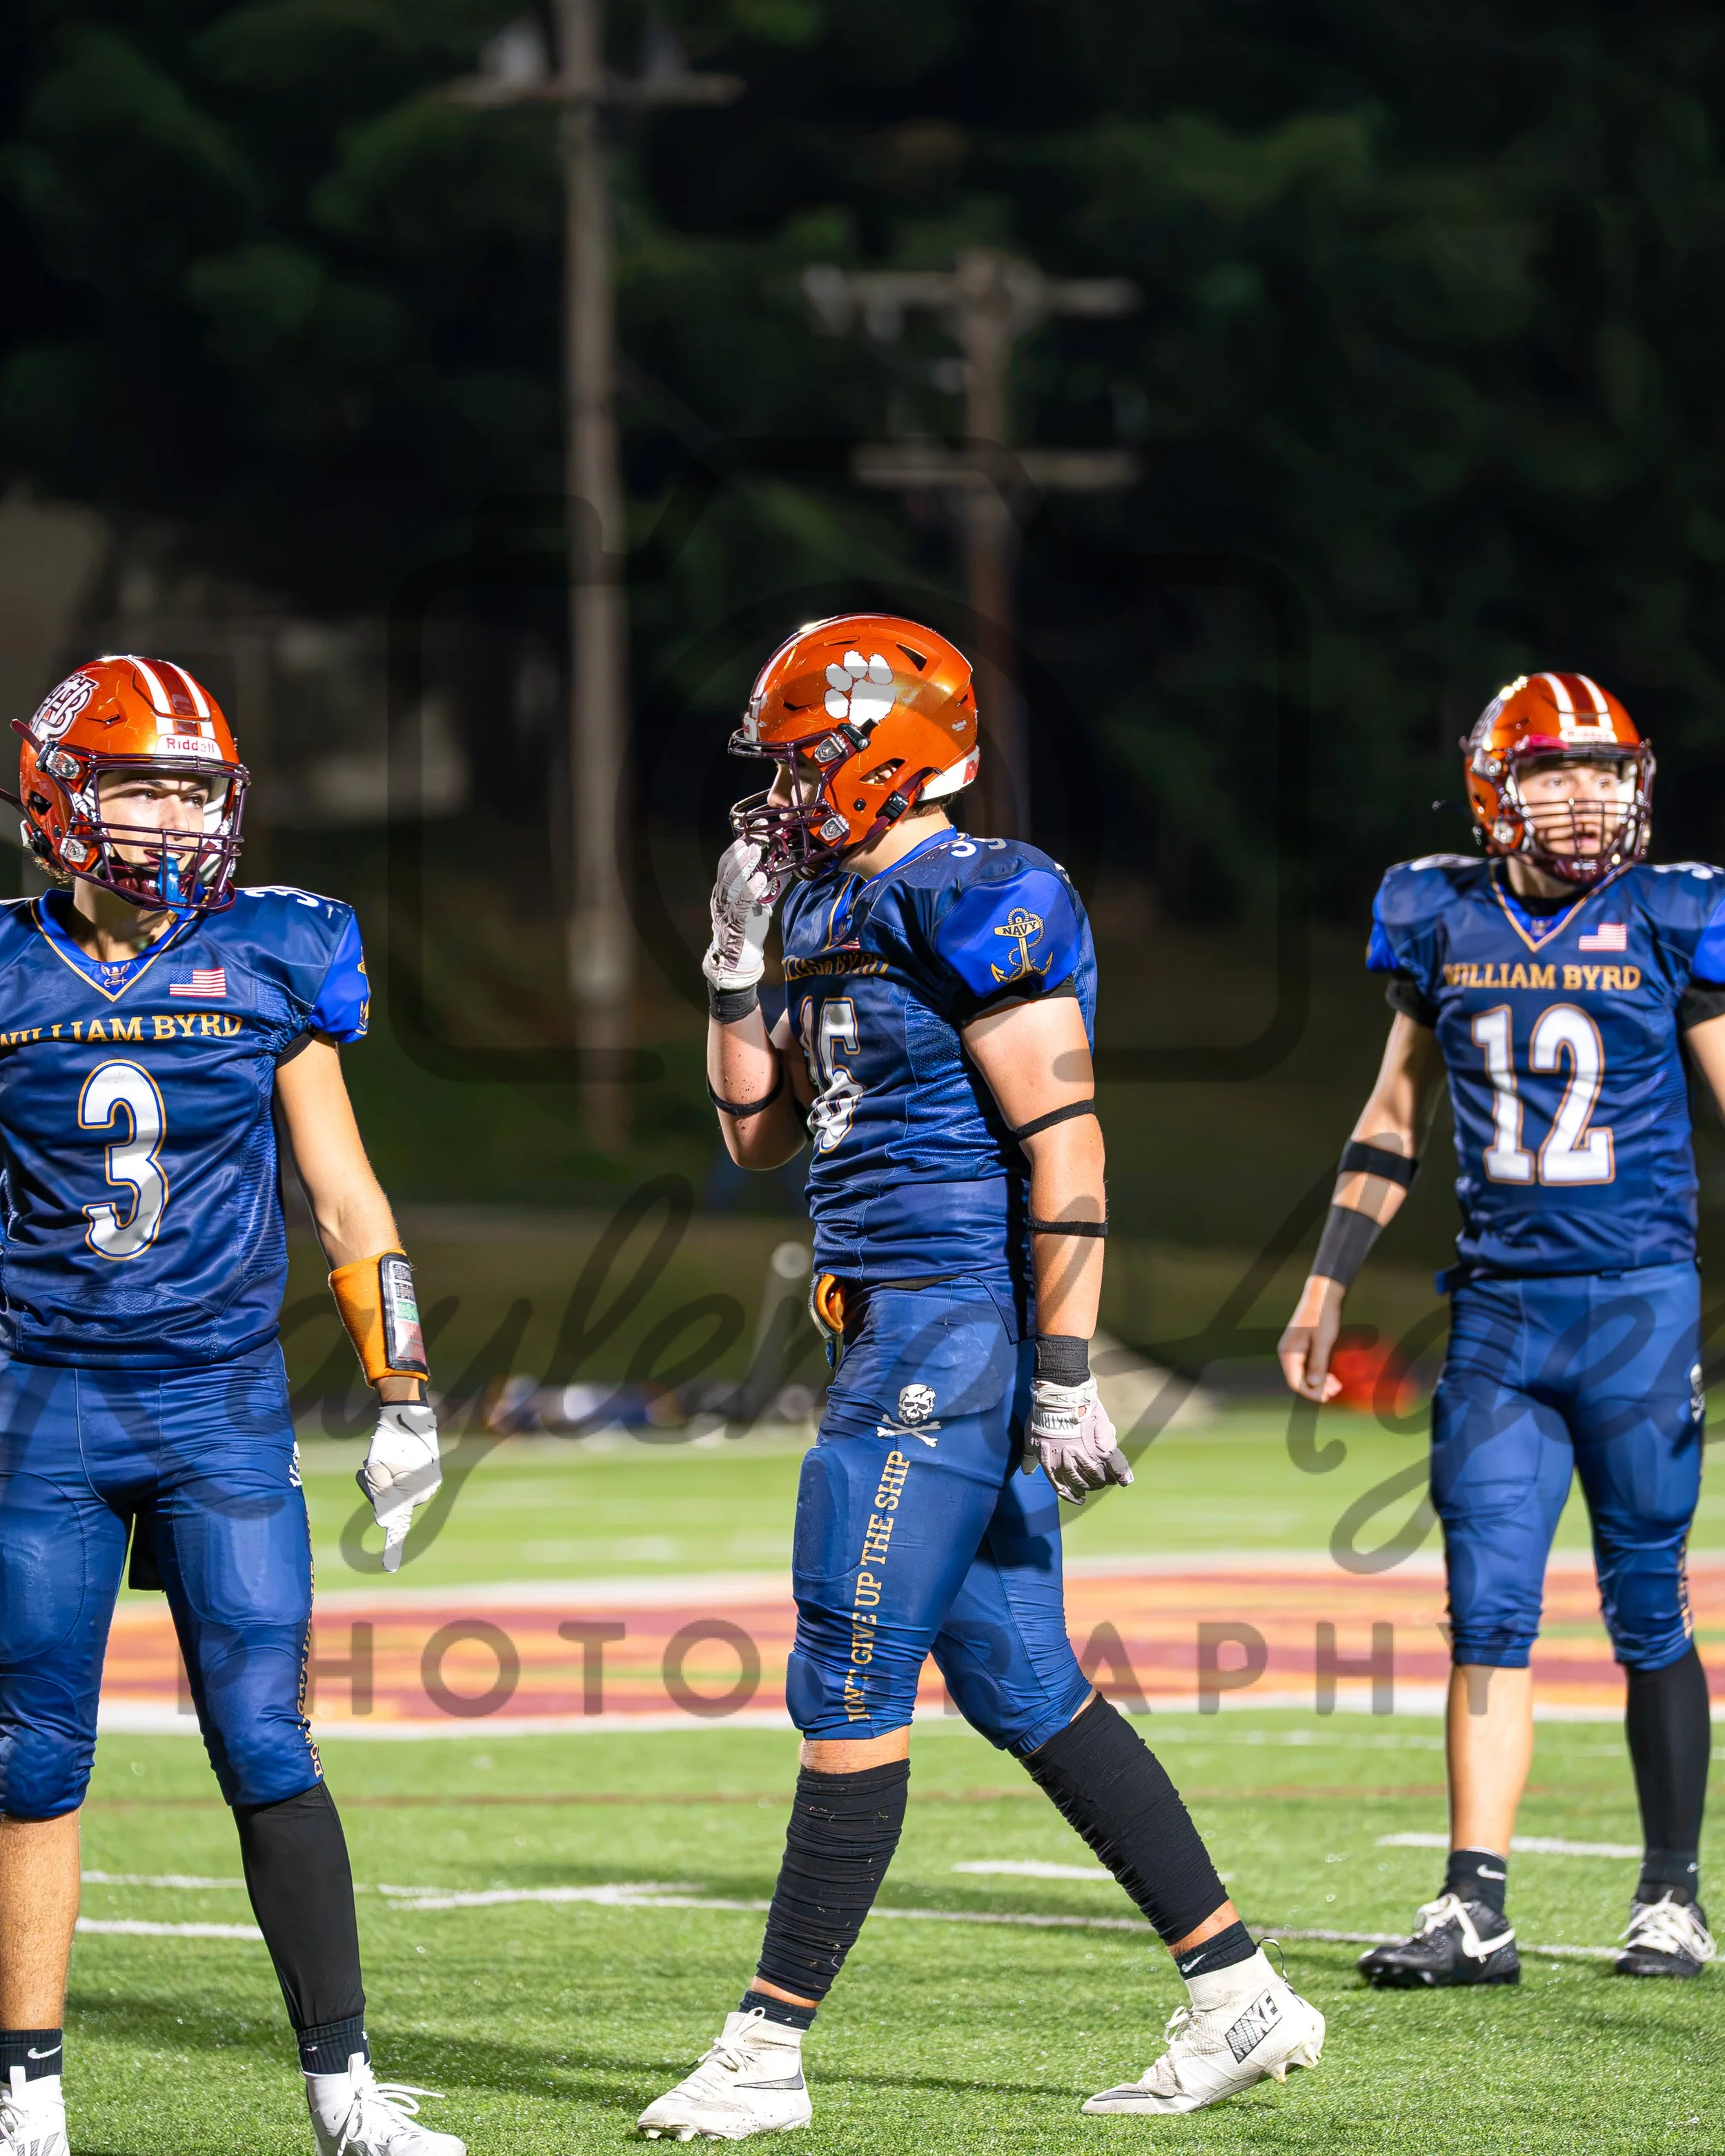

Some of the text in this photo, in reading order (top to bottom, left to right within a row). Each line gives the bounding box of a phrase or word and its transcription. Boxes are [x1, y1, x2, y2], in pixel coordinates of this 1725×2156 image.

[1003, 922, 1036, 936] NAVY
[1443, 963, 1641, 990] WILLIAM BYRD
[153, 1013, 242, 1040] BYRD
[1472, 1004, 1615, 1185] 12
[78, 1059, 168, 1261] 3
[874, 1450, 910, 1511] SHIP
[860, 1514, 894, 1565] THE
[854, 1572, 882, 1606] UP
[851, 1612, 877, 1665] GIVE
